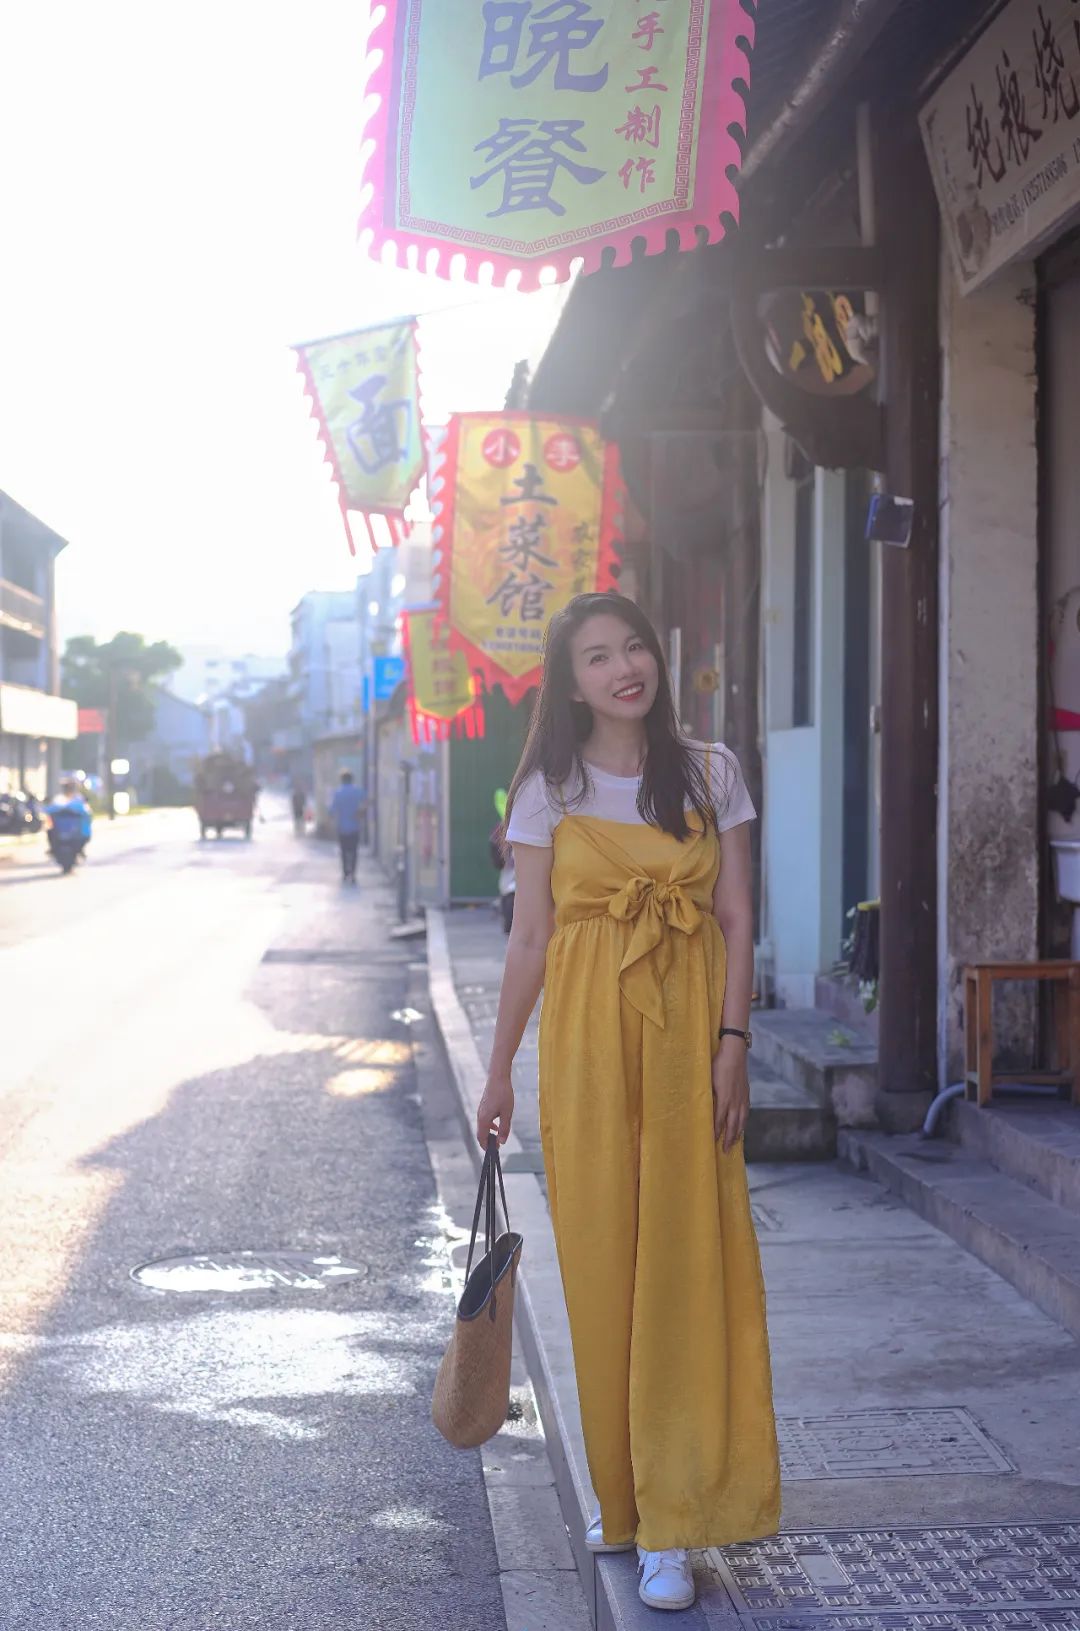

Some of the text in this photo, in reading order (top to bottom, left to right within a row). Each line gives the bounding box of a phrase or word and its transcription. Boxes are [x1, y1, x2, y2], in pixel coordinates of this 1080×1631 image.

[470, 0, 609, 218] 晚餐
[615, 11, 668, 193] 手工制作
[966, 0, 1080, 189] 纯粮烧
[486, 464, 559, 622] 土菜馆
